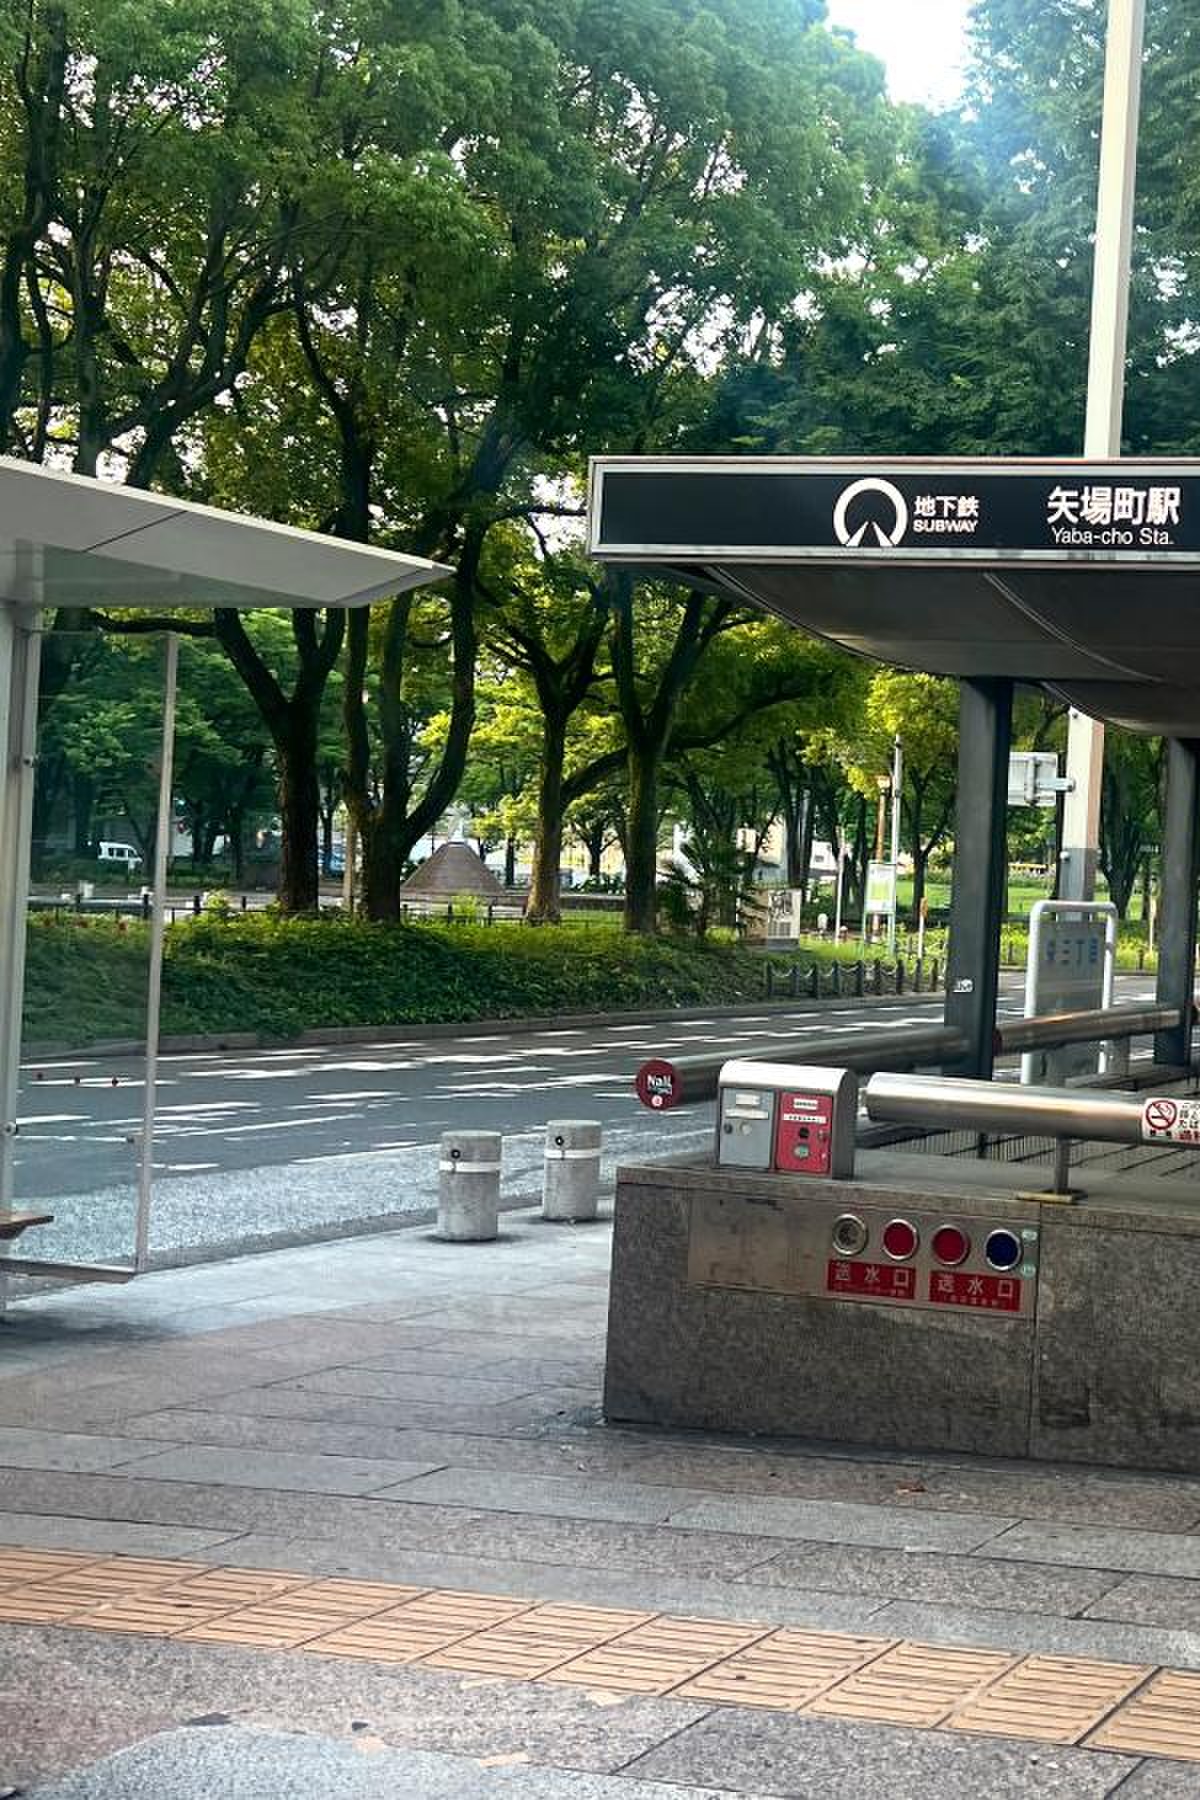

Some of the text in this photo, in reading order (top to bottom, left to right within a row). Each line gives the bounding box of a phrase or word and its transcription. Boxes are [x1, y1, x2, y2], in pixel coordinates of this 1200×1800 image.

[913, 495, 979, 518] 地下鉄
[1047, 485, 1181, 526] 矢場町駅
[913, 518, 979, 533] SUBWAY
[1051, 526, 1174, 545] Yaba-cho Sta.
[937, 1276, 1014, 1298] 送水口
